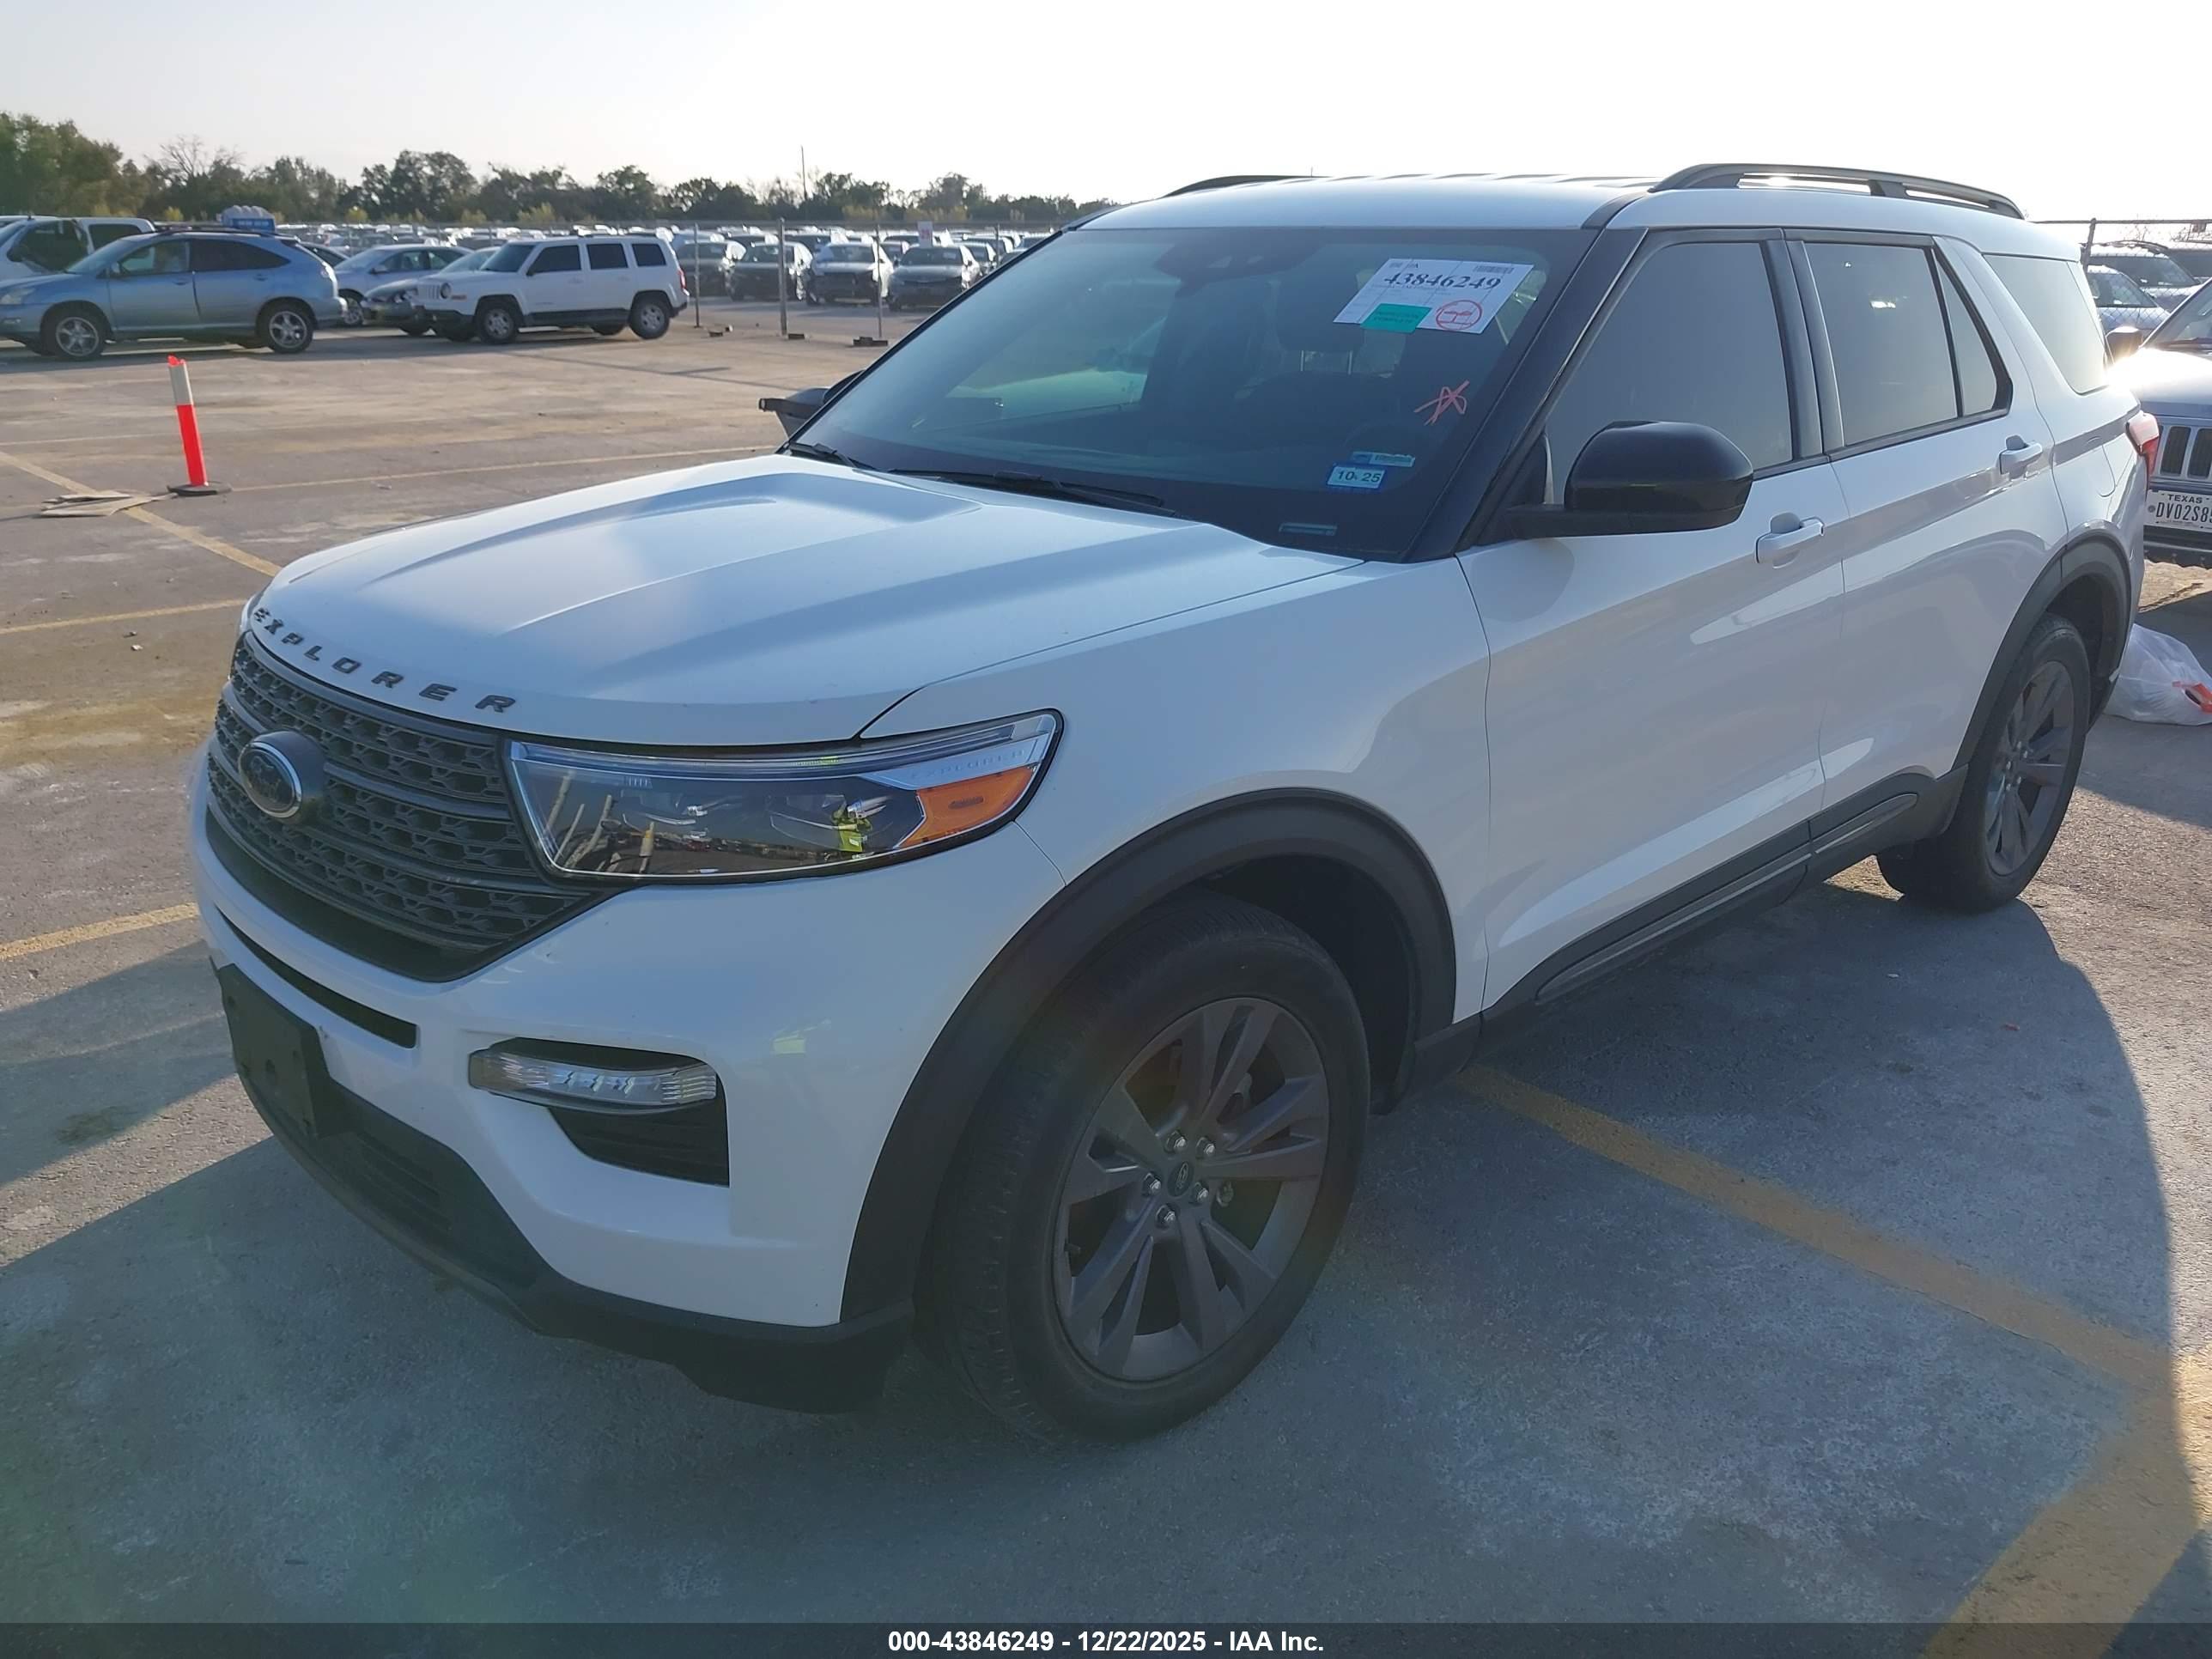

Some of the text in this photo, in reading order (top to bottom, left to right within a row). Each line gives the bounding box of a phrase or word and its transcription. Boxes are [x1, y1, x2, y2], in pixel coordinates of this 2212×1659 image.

[1383, 272, 1503, 289] 43846249
[1338, 470, 1382, 483] 10 25
[2168, 494, 2203, 504] TEXAS
[2155, 501, 2212, 523] DV02S8
[253, 607, 516, 714] EXPLORER
